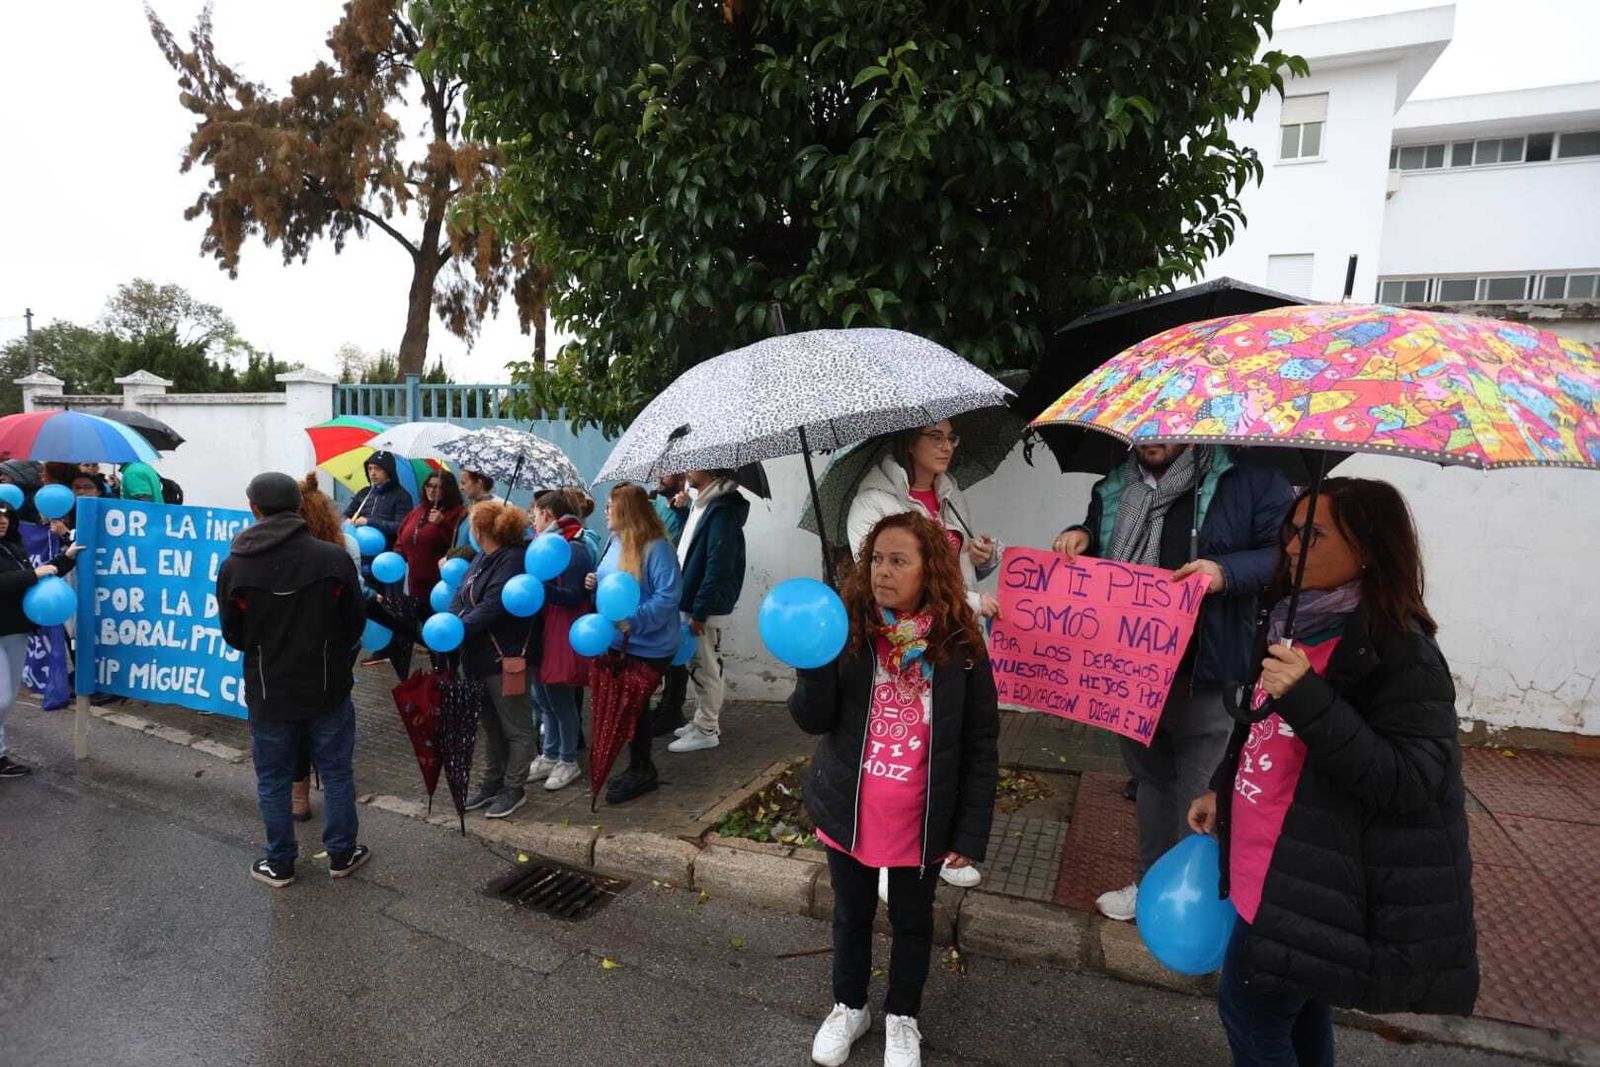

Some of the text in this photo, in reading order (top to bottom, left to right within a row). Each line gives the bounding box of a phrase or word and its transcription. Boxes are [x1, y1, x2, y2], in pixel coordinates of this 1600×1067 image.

[165, 514, 197, 539] LA
[158, 548, 193, 578] EN
[1005, 556, 1059, 593] SIN
[1065, 562, 1092, 597] TI
[1096, 561, 1172, 608] PTIS
[94, 586, 145, 616] POR
[161, 587, 193, 617] LA
[1013, 598, 1180, 655] SOMOS NADA
[992, 630, 1022, 654] POR
[1033, 640, 1072, 662] LOS
[1082, 648, 1160, 682] DERECHOS
[990, 657, 1069, 685] NUESTROS
[1079, 673, 1130, 698] HIJOS
